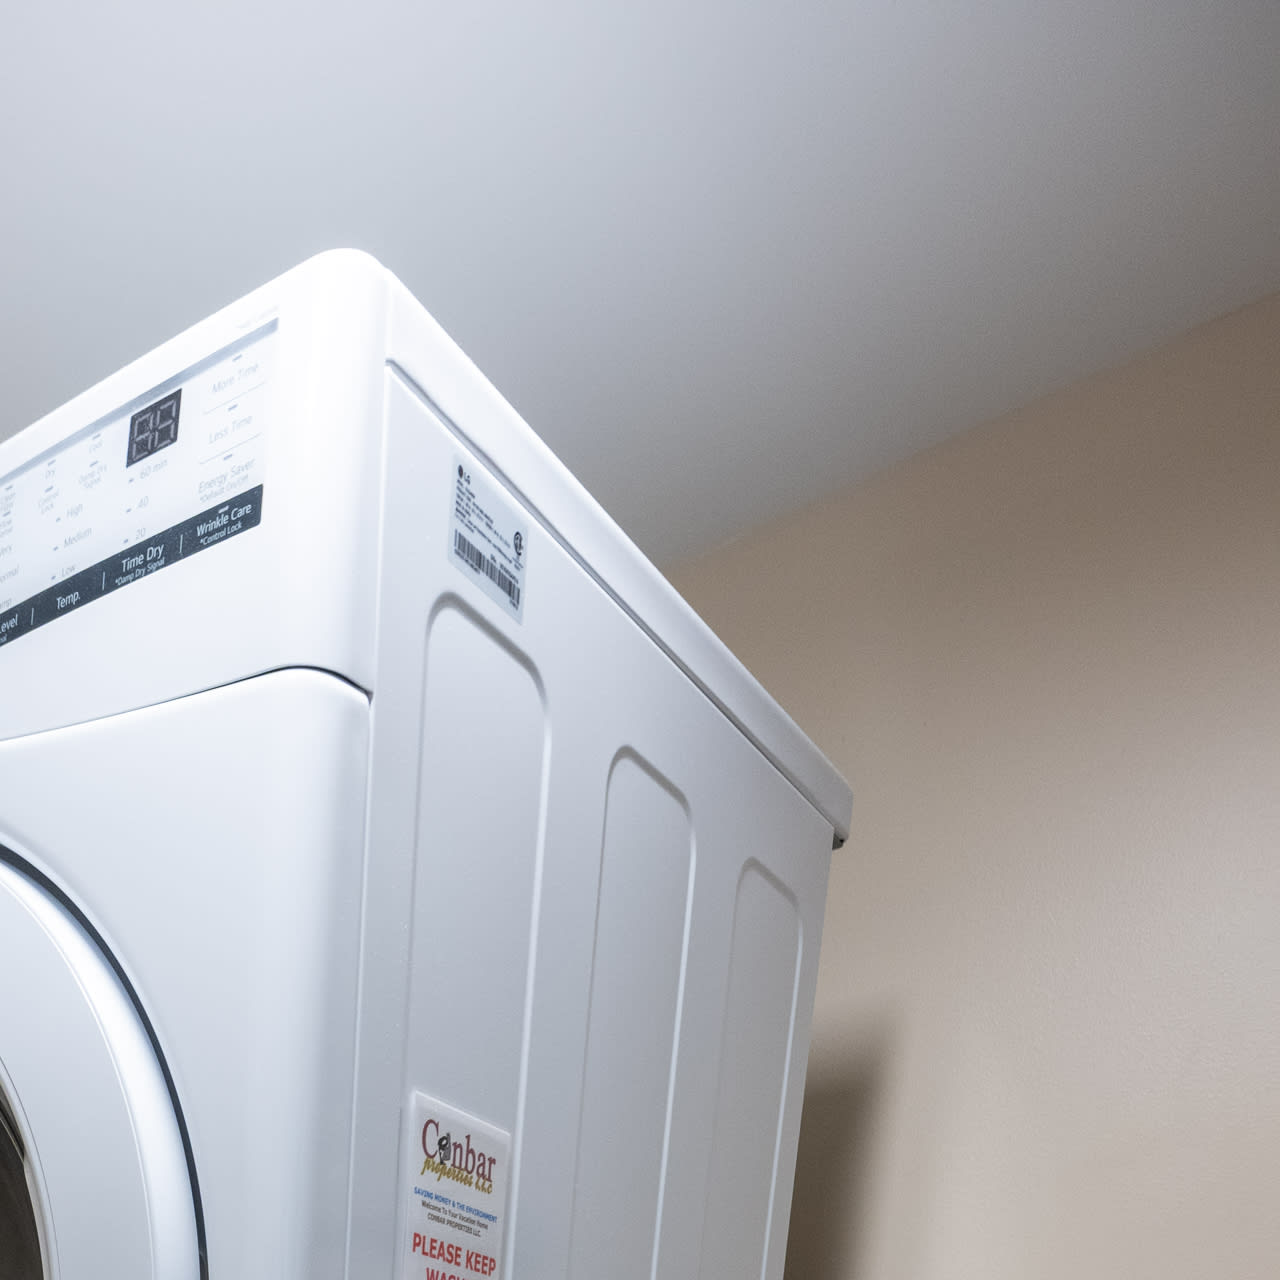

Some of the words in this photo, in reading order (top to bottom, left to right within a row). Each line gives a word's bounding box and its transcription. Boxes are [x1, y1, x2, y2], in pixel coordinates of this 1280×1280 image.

[208, 426, 229, 444] Less
[230, 415, 253, 433] Time
[139, 464, 152, 479] 60
[198, 470, 228, 494] Energy
[230, 458, 256, 477] Saver
[66, 503, 83, 519] High
[137, 496, 149, 509] 40
[196, 513, 229, 537] Wrinkle
[230, 504, 252, 521] Care
[226, 521, 243, 537] Lock
[64, 527, 92, 549] Medium
[121, 555, 144, 573] Time
[146, 543, 164, 562] Dry
[56, 591, 81, 611] Temp.
[420, 1157, 473, 1187] properties
[413, 1186, 434, 1200] SAVING
[412, 1231, 462, 1267] PLEASE
[465, 1249, 497, 1277] KEEP
